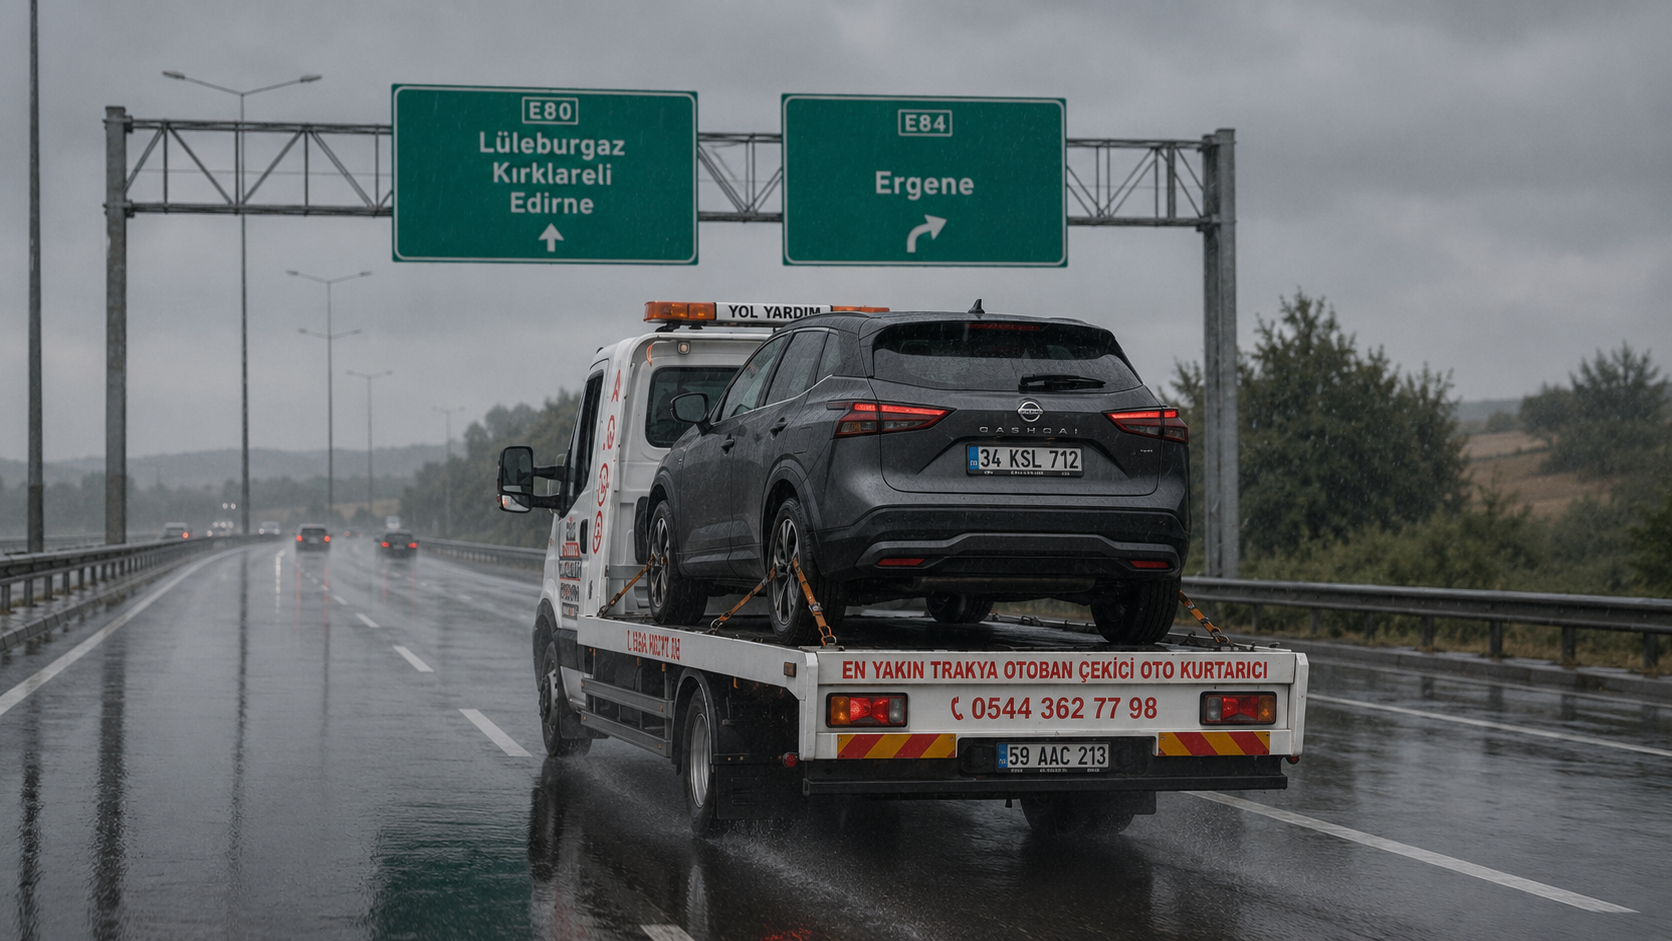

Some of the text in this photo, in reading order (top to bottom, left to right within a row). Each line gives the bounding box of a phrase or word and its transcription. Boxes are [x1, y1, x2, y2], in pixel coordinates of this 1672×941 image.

[528, 101, 572, 120] E80
[904, 114, 946, 132] E84
[479, 131, 625, 161] Lüleburgaz
[493, 161, 612, 186] Kırklareli
[875, 170, 974, 200] Ergene
[510, 191, 594, 215] Edirne
[729, 305, 821, 319] YOL YARDIM
[980, 448, 1079, 469] 34 KSL 712
[842, 656, 1268, 683] EN YAKIN TRAKYA OTOBAN ÇEKİCİ OTO KURTARICI
[972, 696, 1158, 719] 0544 362 77 98
[1009, 745, 1106, 766] 59 AAC 213
